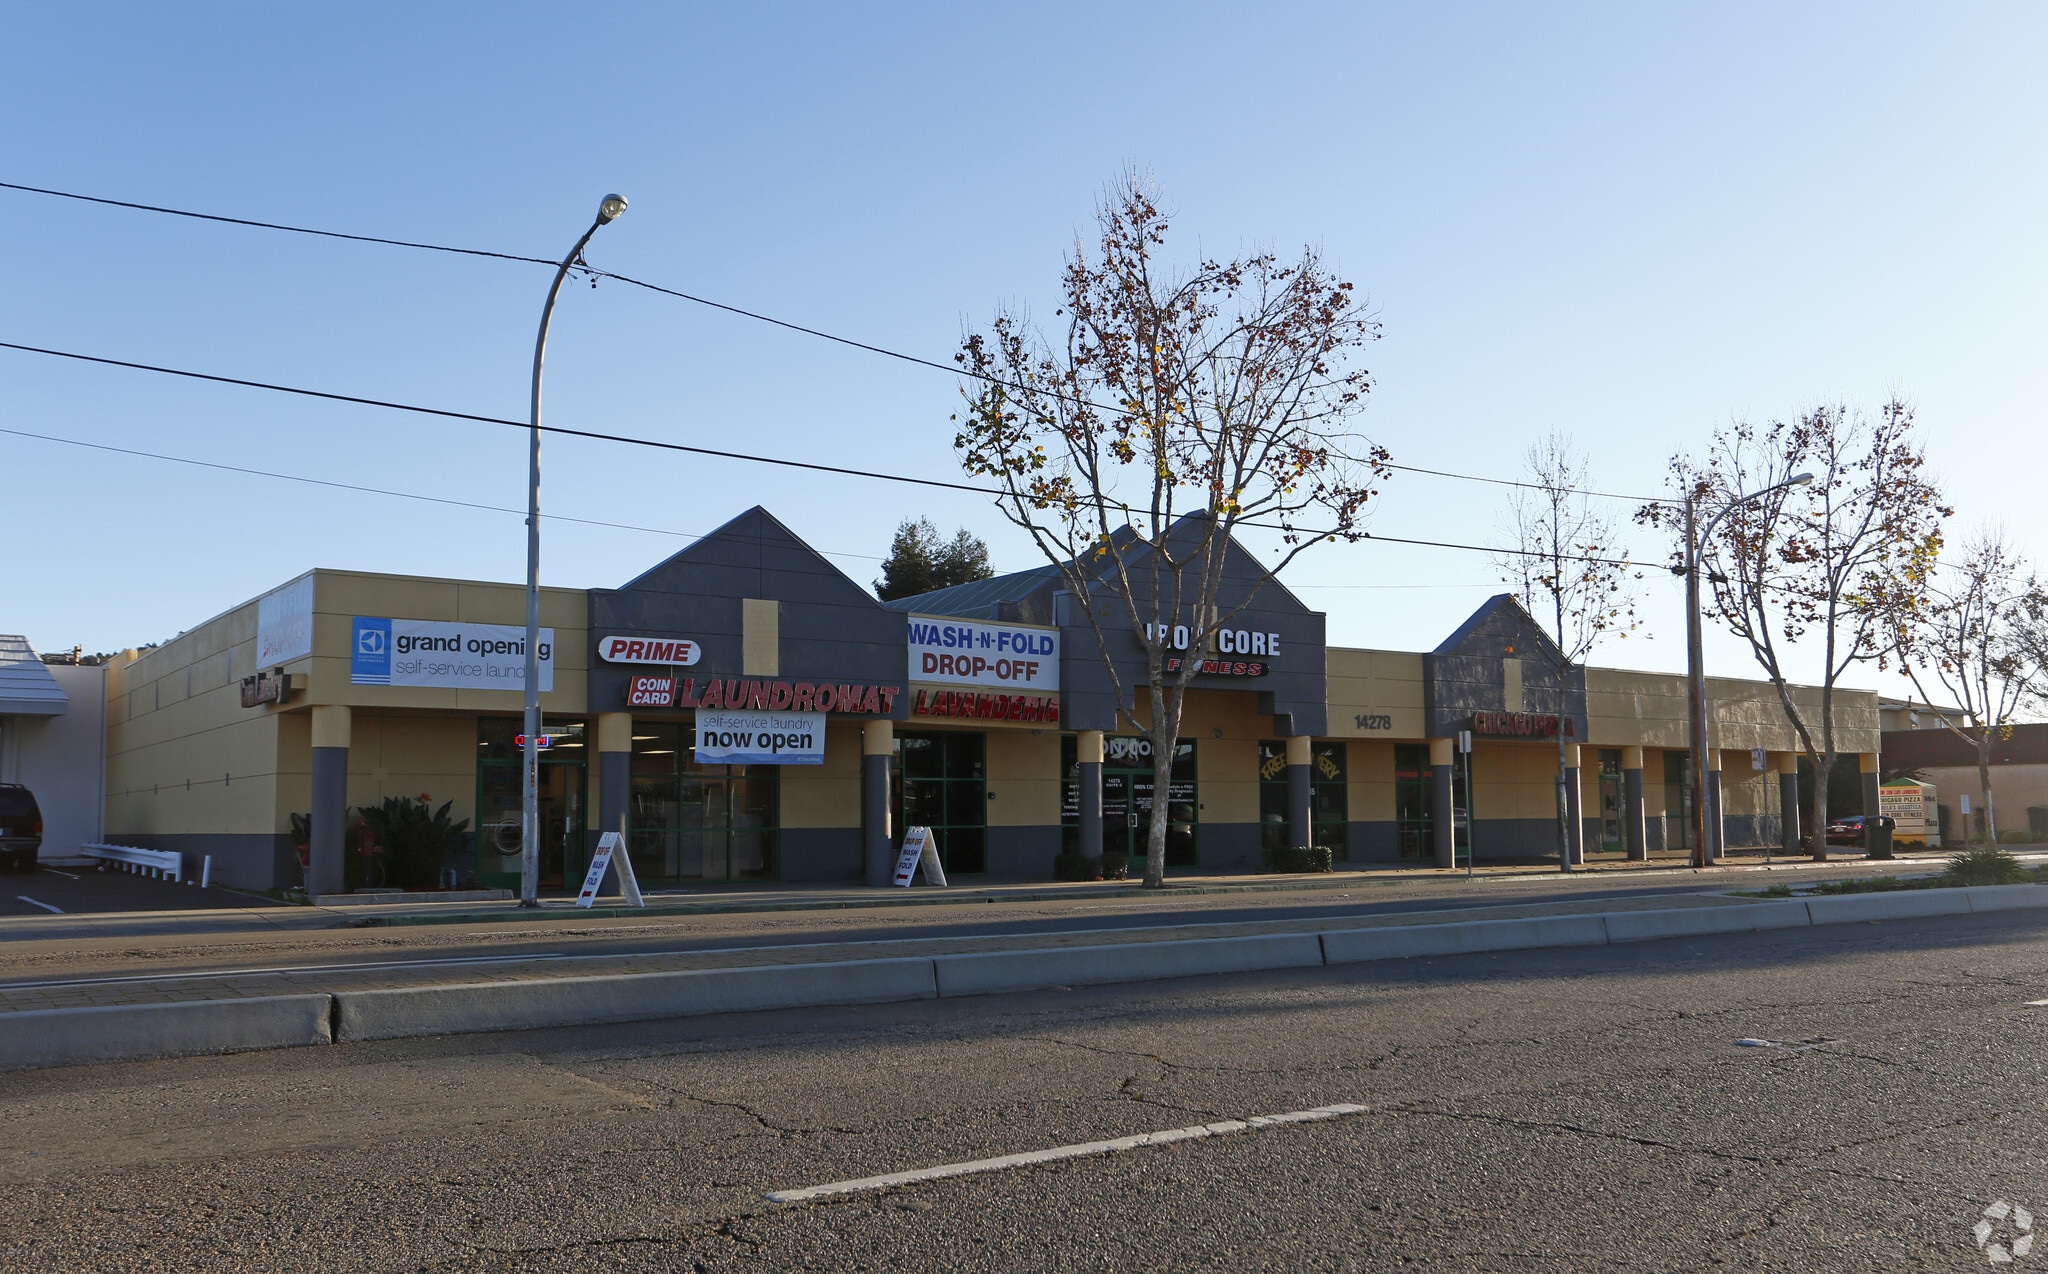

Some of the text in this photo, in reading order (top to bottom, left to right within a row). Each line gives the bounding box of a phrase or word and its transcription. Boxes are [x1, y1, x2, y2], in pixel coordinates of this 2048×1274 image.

[397, 632, 551, 661] grand openig
[608, 639, 692, 662] PRIME
[1219, 629, 1281, 656] CORE
[396, 658, 526, 679] self-service laund
[922, 652, 1040, 682] DROP-OFF
[1167, 658, 1262, 676] FNESS
[637, 677, 671, 692] COIN
[631, 690, 671, 706] CARD
[680, 678, 900, 713] LAUNDROMAT
[915, 689, 1059, 722] LAVANDERIA
[703, 714, 813, 732] self-service laundry
[1354, 714, 1392, 730] 14278
[1474, 711, 1575, 738] CHICAGO PIZA
[514, 735, 547, 745] ON
[703, 731, 813, 754] now open
[902, 849, 918, 857] WASH
[592, 861, 605, 869] WASH
[586, 877, 598, 885] FOLD
